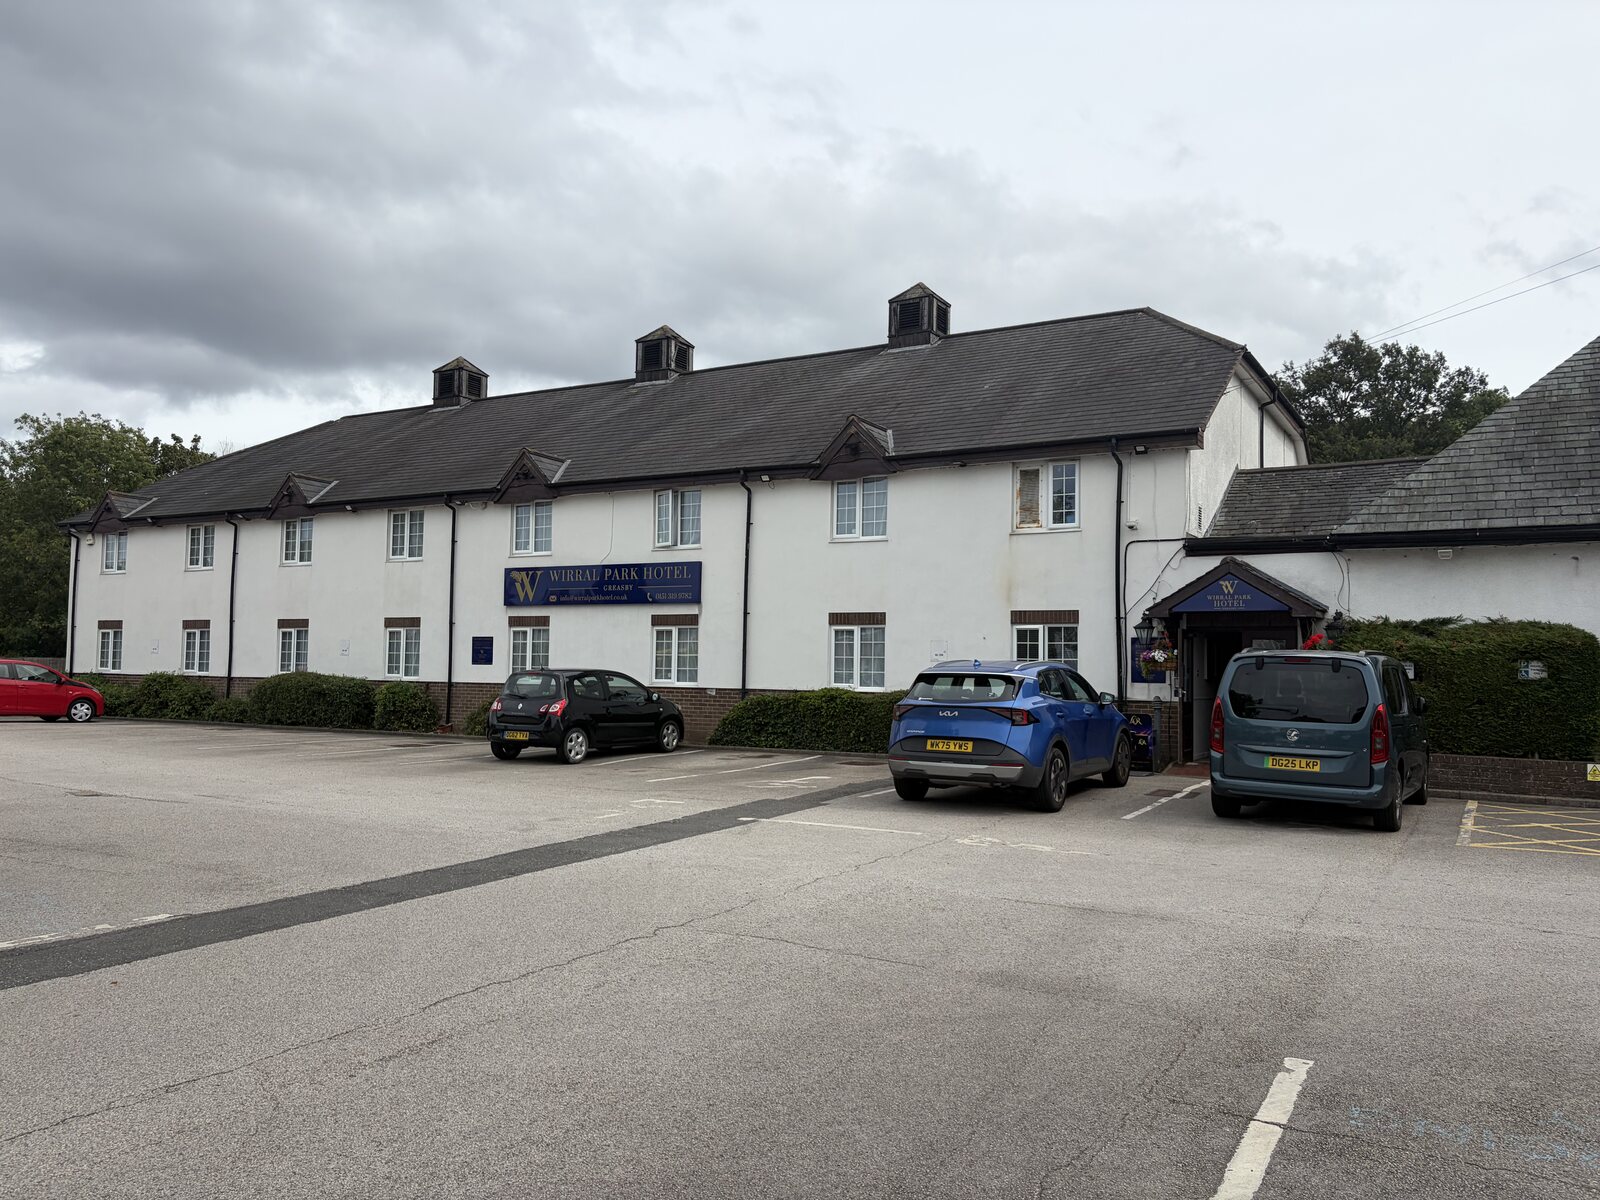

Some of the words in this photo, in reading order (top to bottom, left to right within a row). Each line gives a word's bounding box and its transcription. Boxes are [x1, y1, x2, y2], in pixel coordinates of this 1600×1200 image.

[550, 569, 599, 582] WIRRAL
[604, 567, 639, 581] PARK
[643, 566, 691, 580] HOTEL
[930, 741, 951, 750] WK75
[953, 742, 969, 751] YWS
[1271, 758, 1297, 768] DG25
[1299, 760, 1319, 770] LKP
